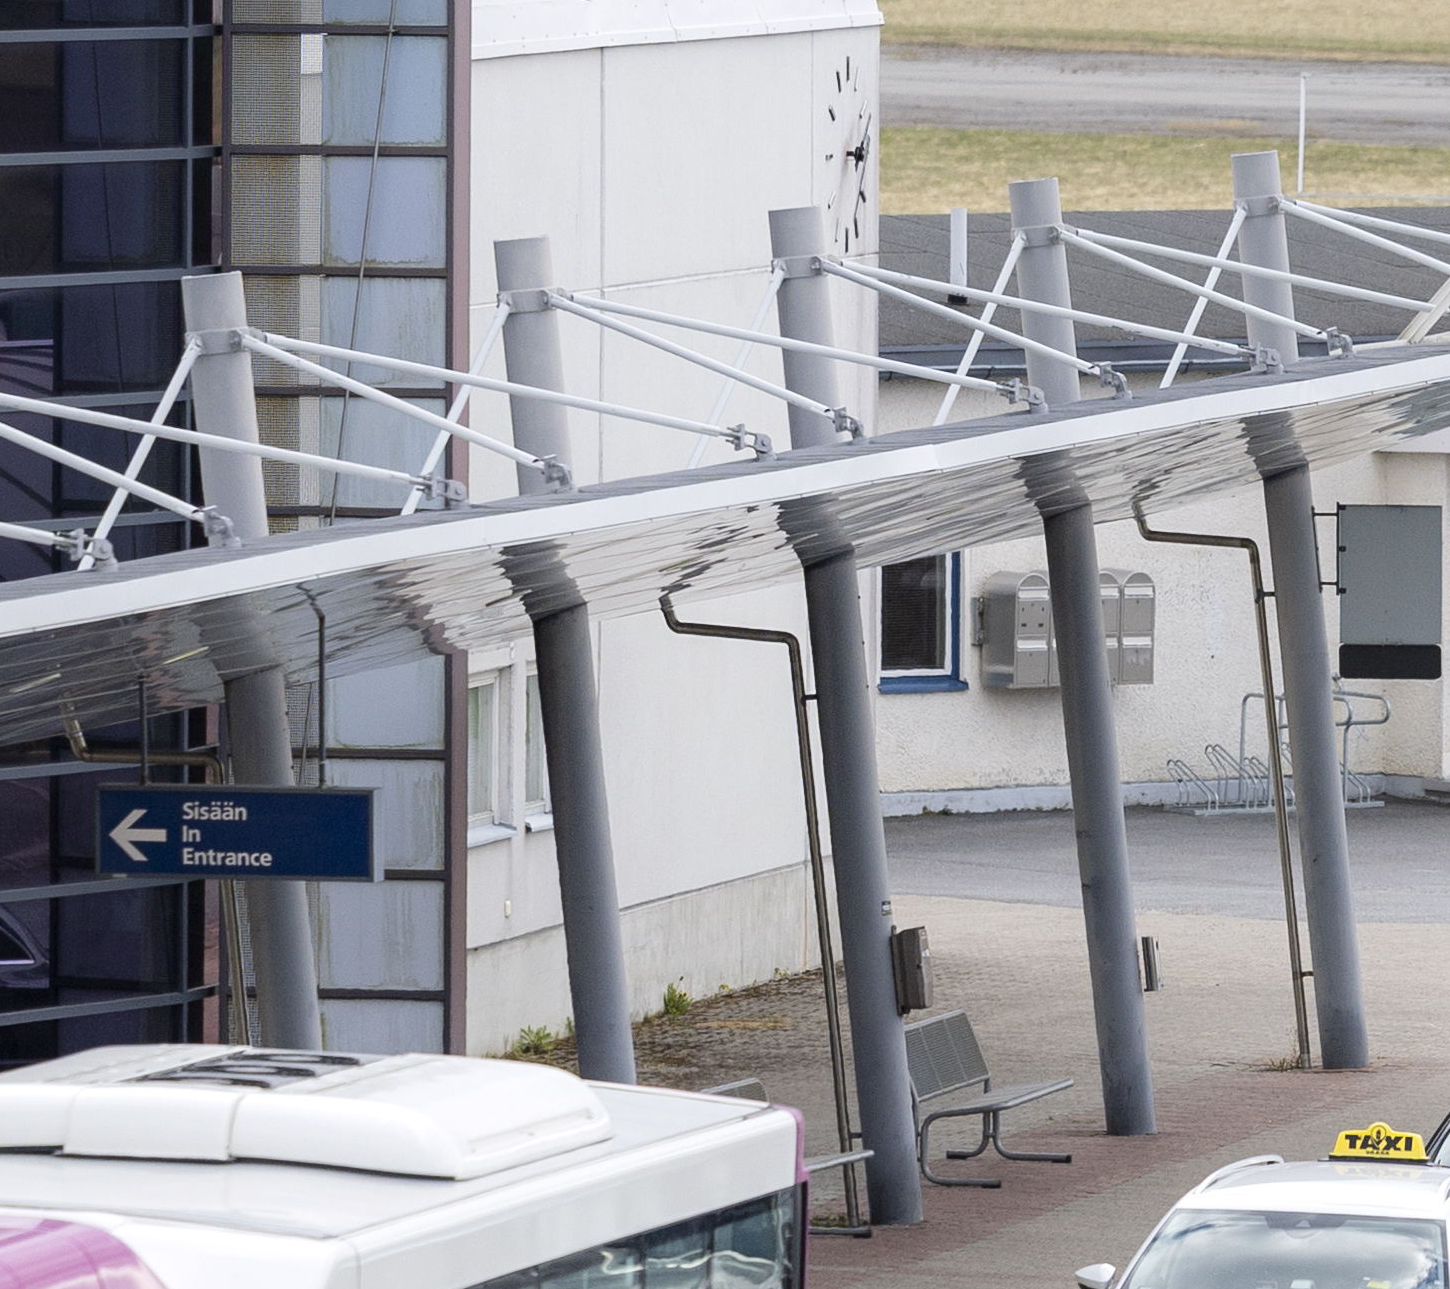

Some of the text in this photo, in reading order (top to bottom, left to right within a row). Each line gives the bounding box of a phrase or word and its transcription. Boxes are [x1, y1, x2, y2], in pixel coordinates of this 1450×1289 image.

[182, 802, 248, 821] Sisään
[182, 825, 201, 843] In
[182, 848, 273, 868] Entrance
[1345, 1134, 1413, 1151] TAXI
